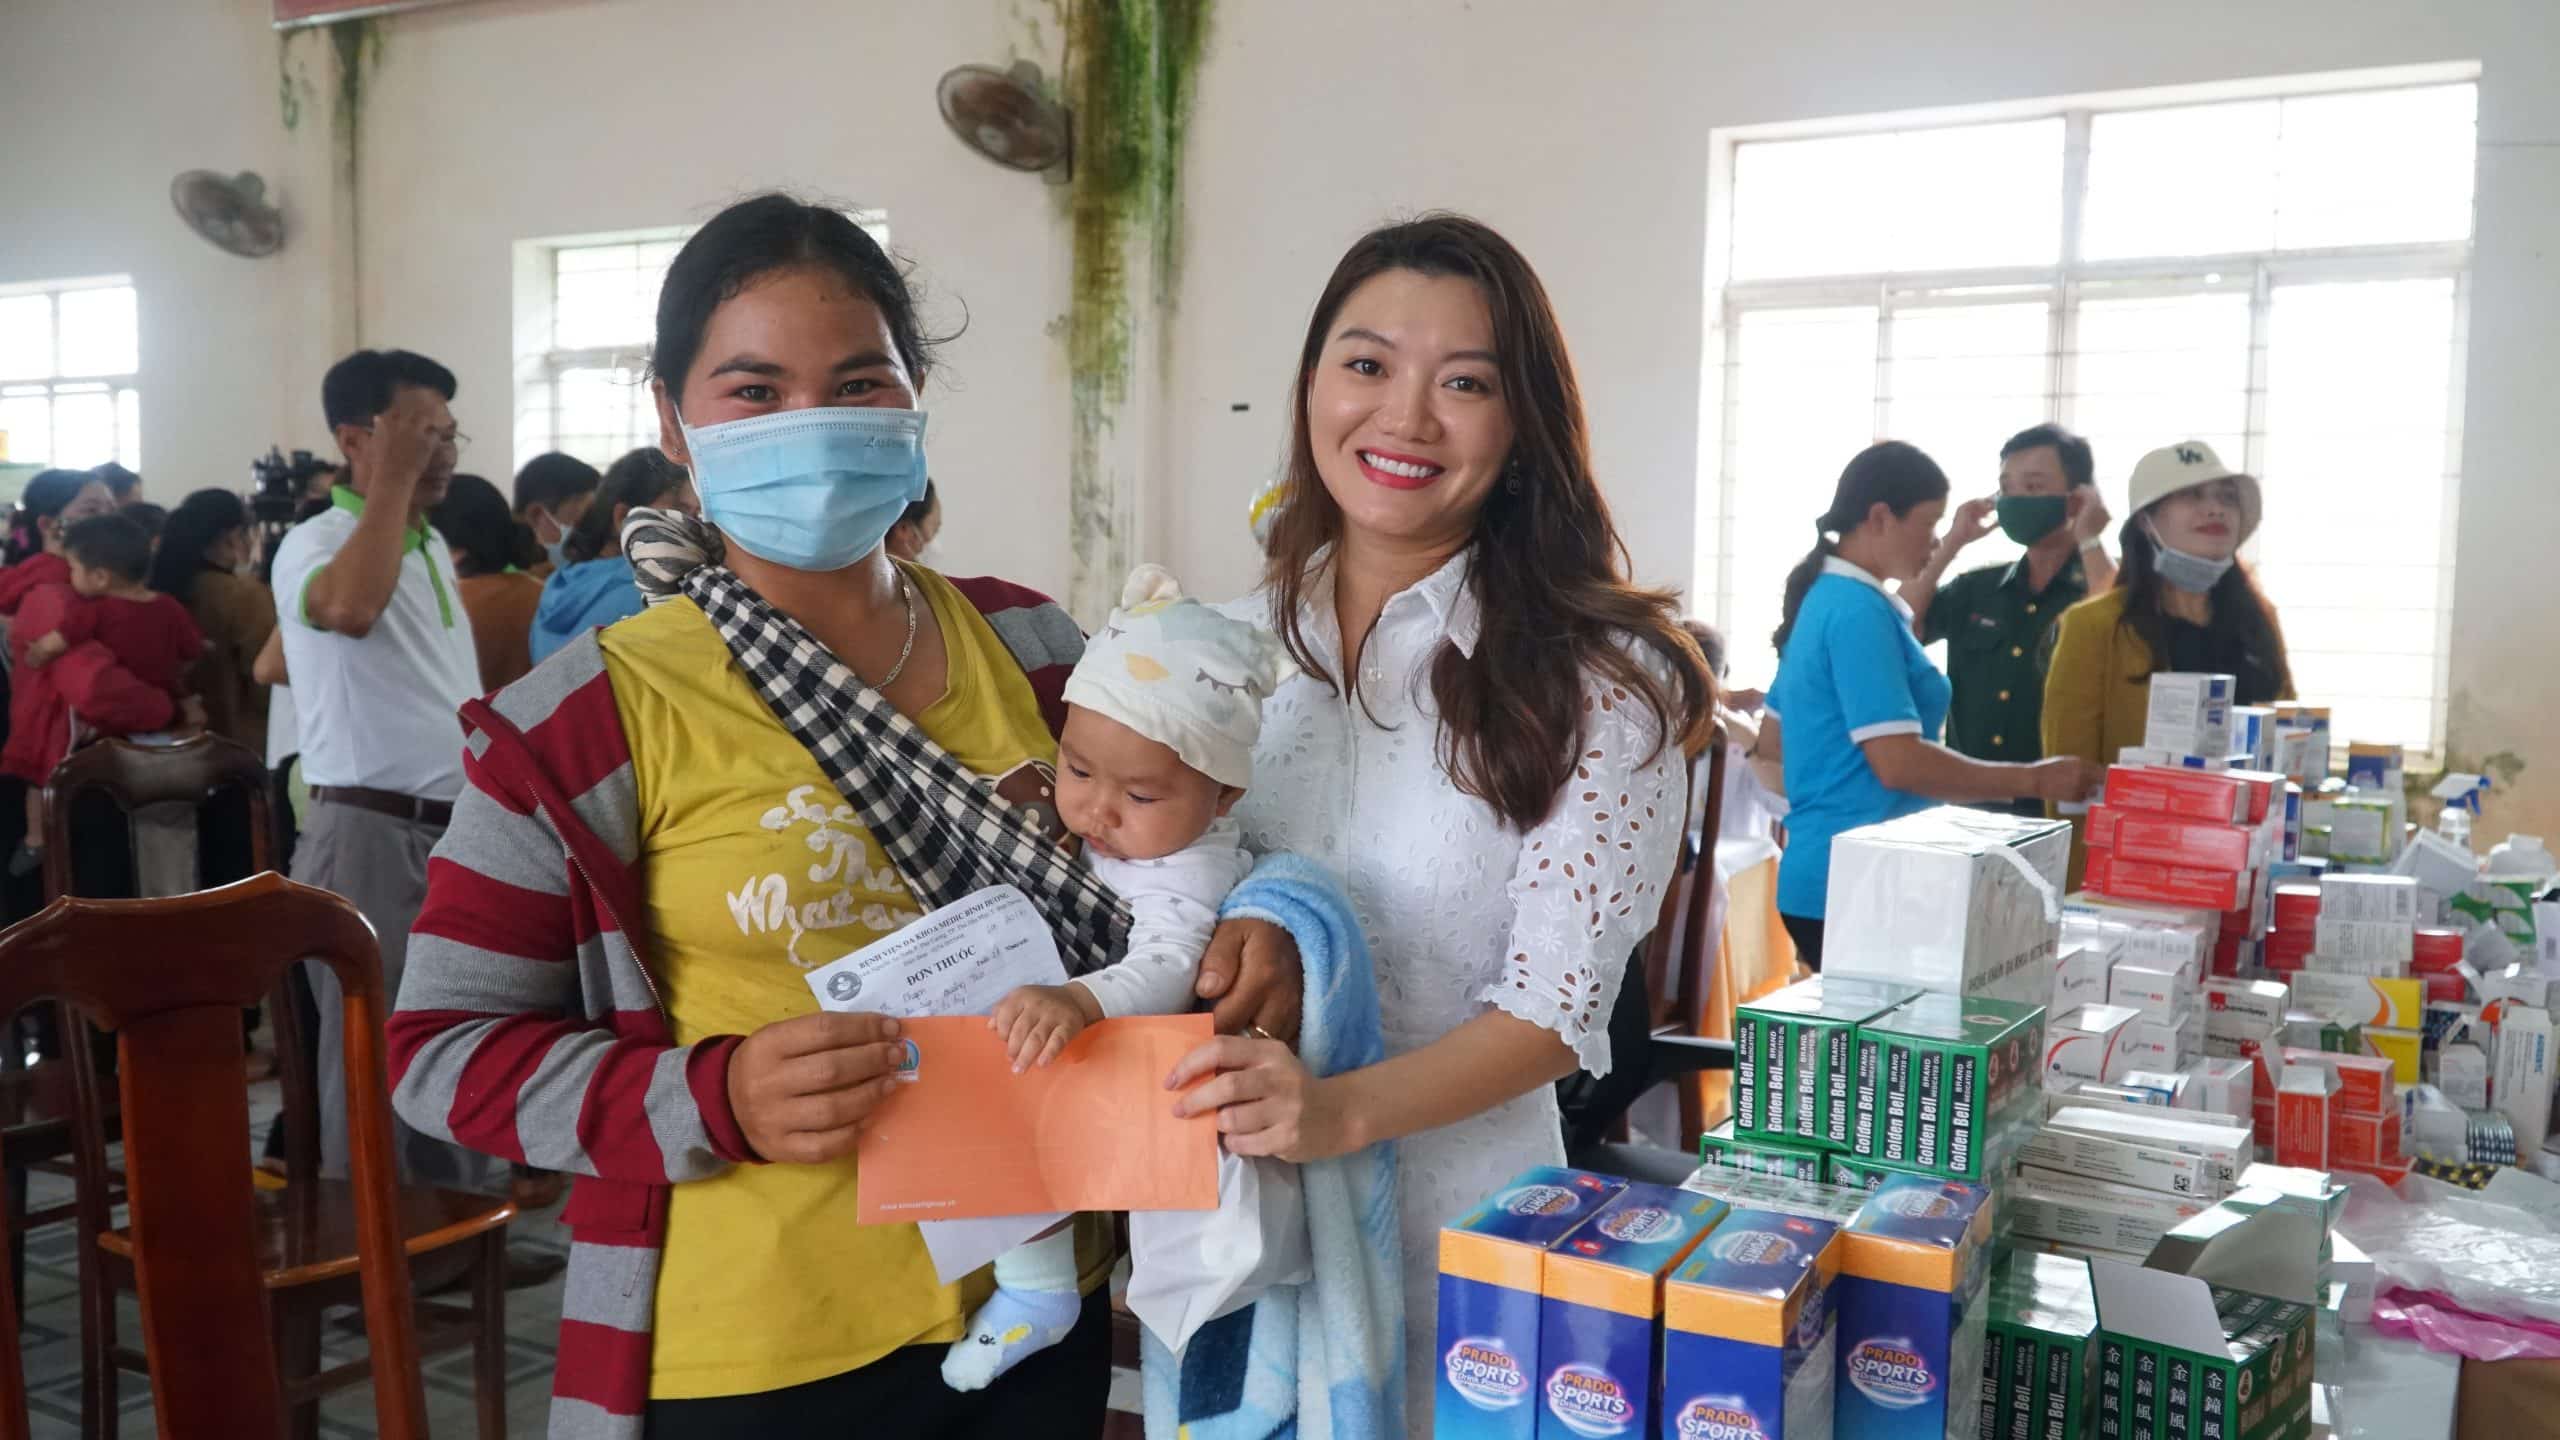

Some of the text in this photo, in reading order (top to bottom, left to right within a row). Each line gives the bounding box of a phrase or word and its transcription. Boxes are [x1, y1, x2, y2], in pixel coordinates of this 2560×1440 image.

[1740, 1027, 1748, 1055] BRAND
[1769, 1031, 1777, 1059] BRAND
[1800, 1034, 1808, 1063] BRAND
[1831, 1038, 1839, 1066] BRAND
[1860, 1049, 1868, 1077] BRAND
[1890, 1053, 1899, 1083] BRAND
[1922, 1058, 1931, 1088] BRAND
[1955, 1063, 1964, 1093] BRAND
[1739, 1062, 1754, 1129] Golden Bell
[1767, 1066, 1784, 1132] Golden Bell
[1798, 1070, 1815, 1137] Golden Bell
[1829, 1073, 1847, 1141] Golden Bell
[1855, 1086, 1874, 1154] Golden Bell
[1886, 1091, 1905, 1160] Golden Bell
[1917, 1097, 1937, 1166] Golden Bell
[1950, 1102, 1970, 1171] Golden Bell
[1461, 1346, 1510, 1367] PRADO
[1864, 1346, 1919, 1367] PRADO
[2050, 1353, 2060, 1384] BRAND
[1451, 1358, 1521, 1386] SPORTS
[1564, 1373, 1616, 1394] PRADO
[1853, 1358, 1929, 1385] SPORTS
[1553, 1385, 1626, 1413] SPORTS
[2014, 1385, 2031, 1411] Bell
[2048, 1393, 2065, 1418] Bell
[1683, 1418, 1762, 1440] SPORTS
[1695, 1406, 1750, 1429] PRADO
